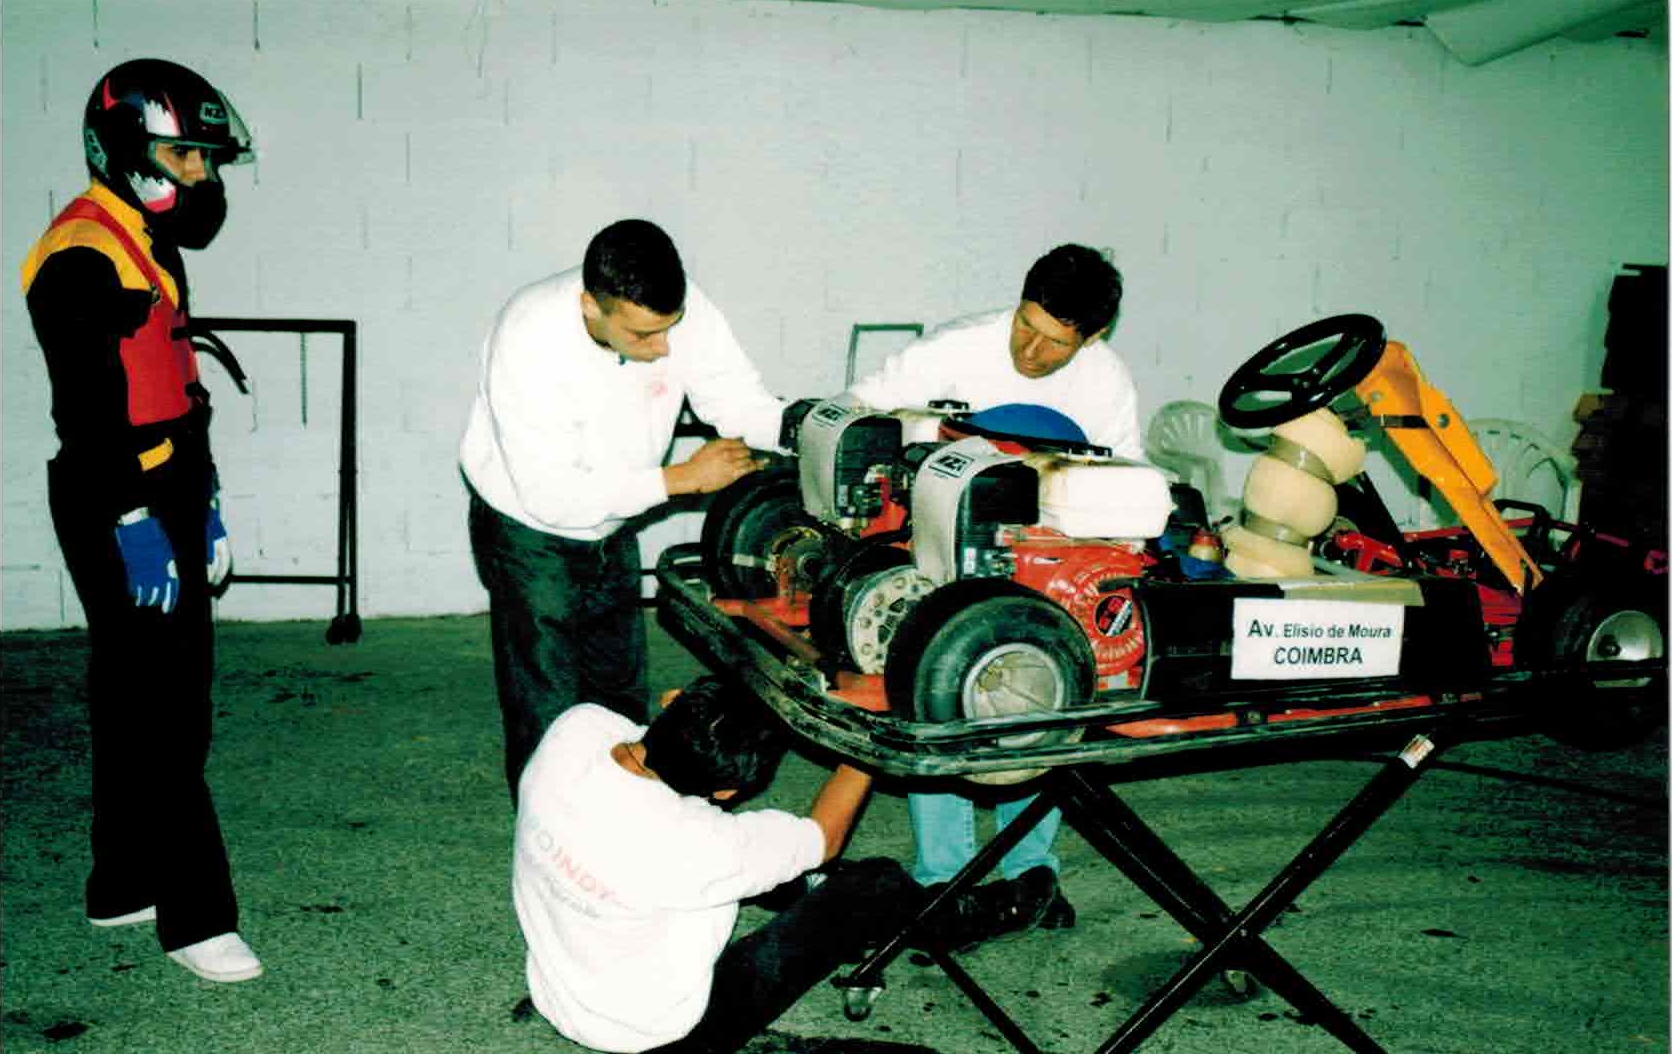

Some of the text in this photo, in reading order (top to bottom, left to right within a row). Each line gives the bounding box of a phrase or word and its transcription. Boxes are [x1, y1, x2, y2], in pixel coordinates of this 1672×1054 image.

[1248, 619, 1278, 638] Av.
[1327, 624, 1345, 638] de
[1348, 624, 1392, 638] Moura
[1274, 646, 1363, 665] COIMBRA
